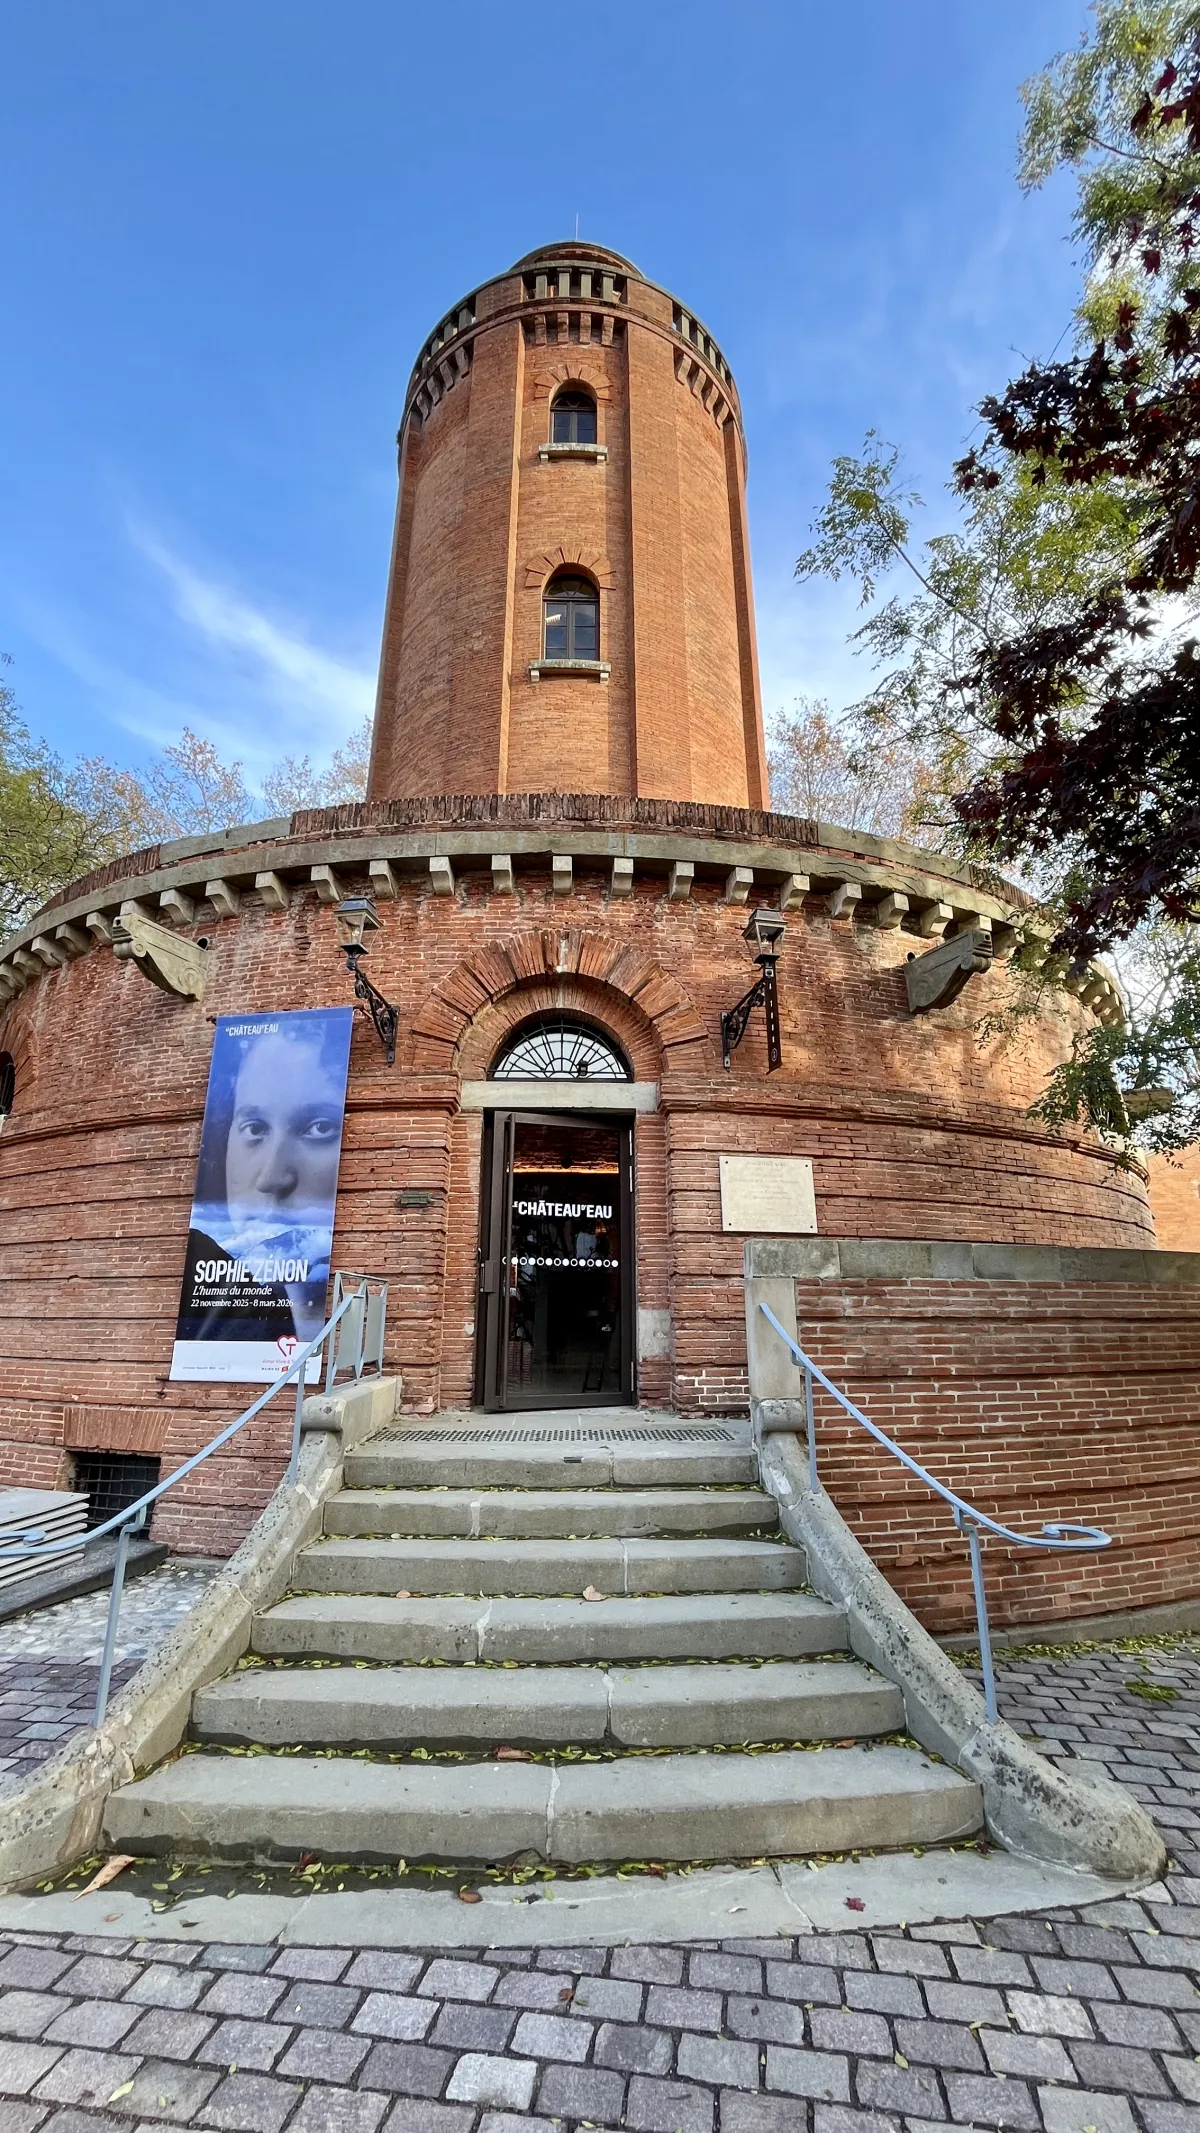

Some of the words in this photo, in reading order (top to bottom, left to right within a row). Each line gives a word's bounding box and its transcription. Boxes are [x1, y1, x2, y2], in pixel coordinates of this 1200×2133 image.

[194, 1260, 249, 1283] SOPHIE
[252, 1254, 308, 1282] ZÉNON
[192, 1285, 229, 1296] L'humus
[229, 1285, 240, 1296] du
[241, 1285, 272, 1296] monde
[191, 1299, 199, 1307] 22
[199, 1298, 231, 1307] novembre
[232, 1299, 249, 1307] 2025
[253, 1299, 259, 1307] 8
[276, 1299, 294, 1307] 2026
